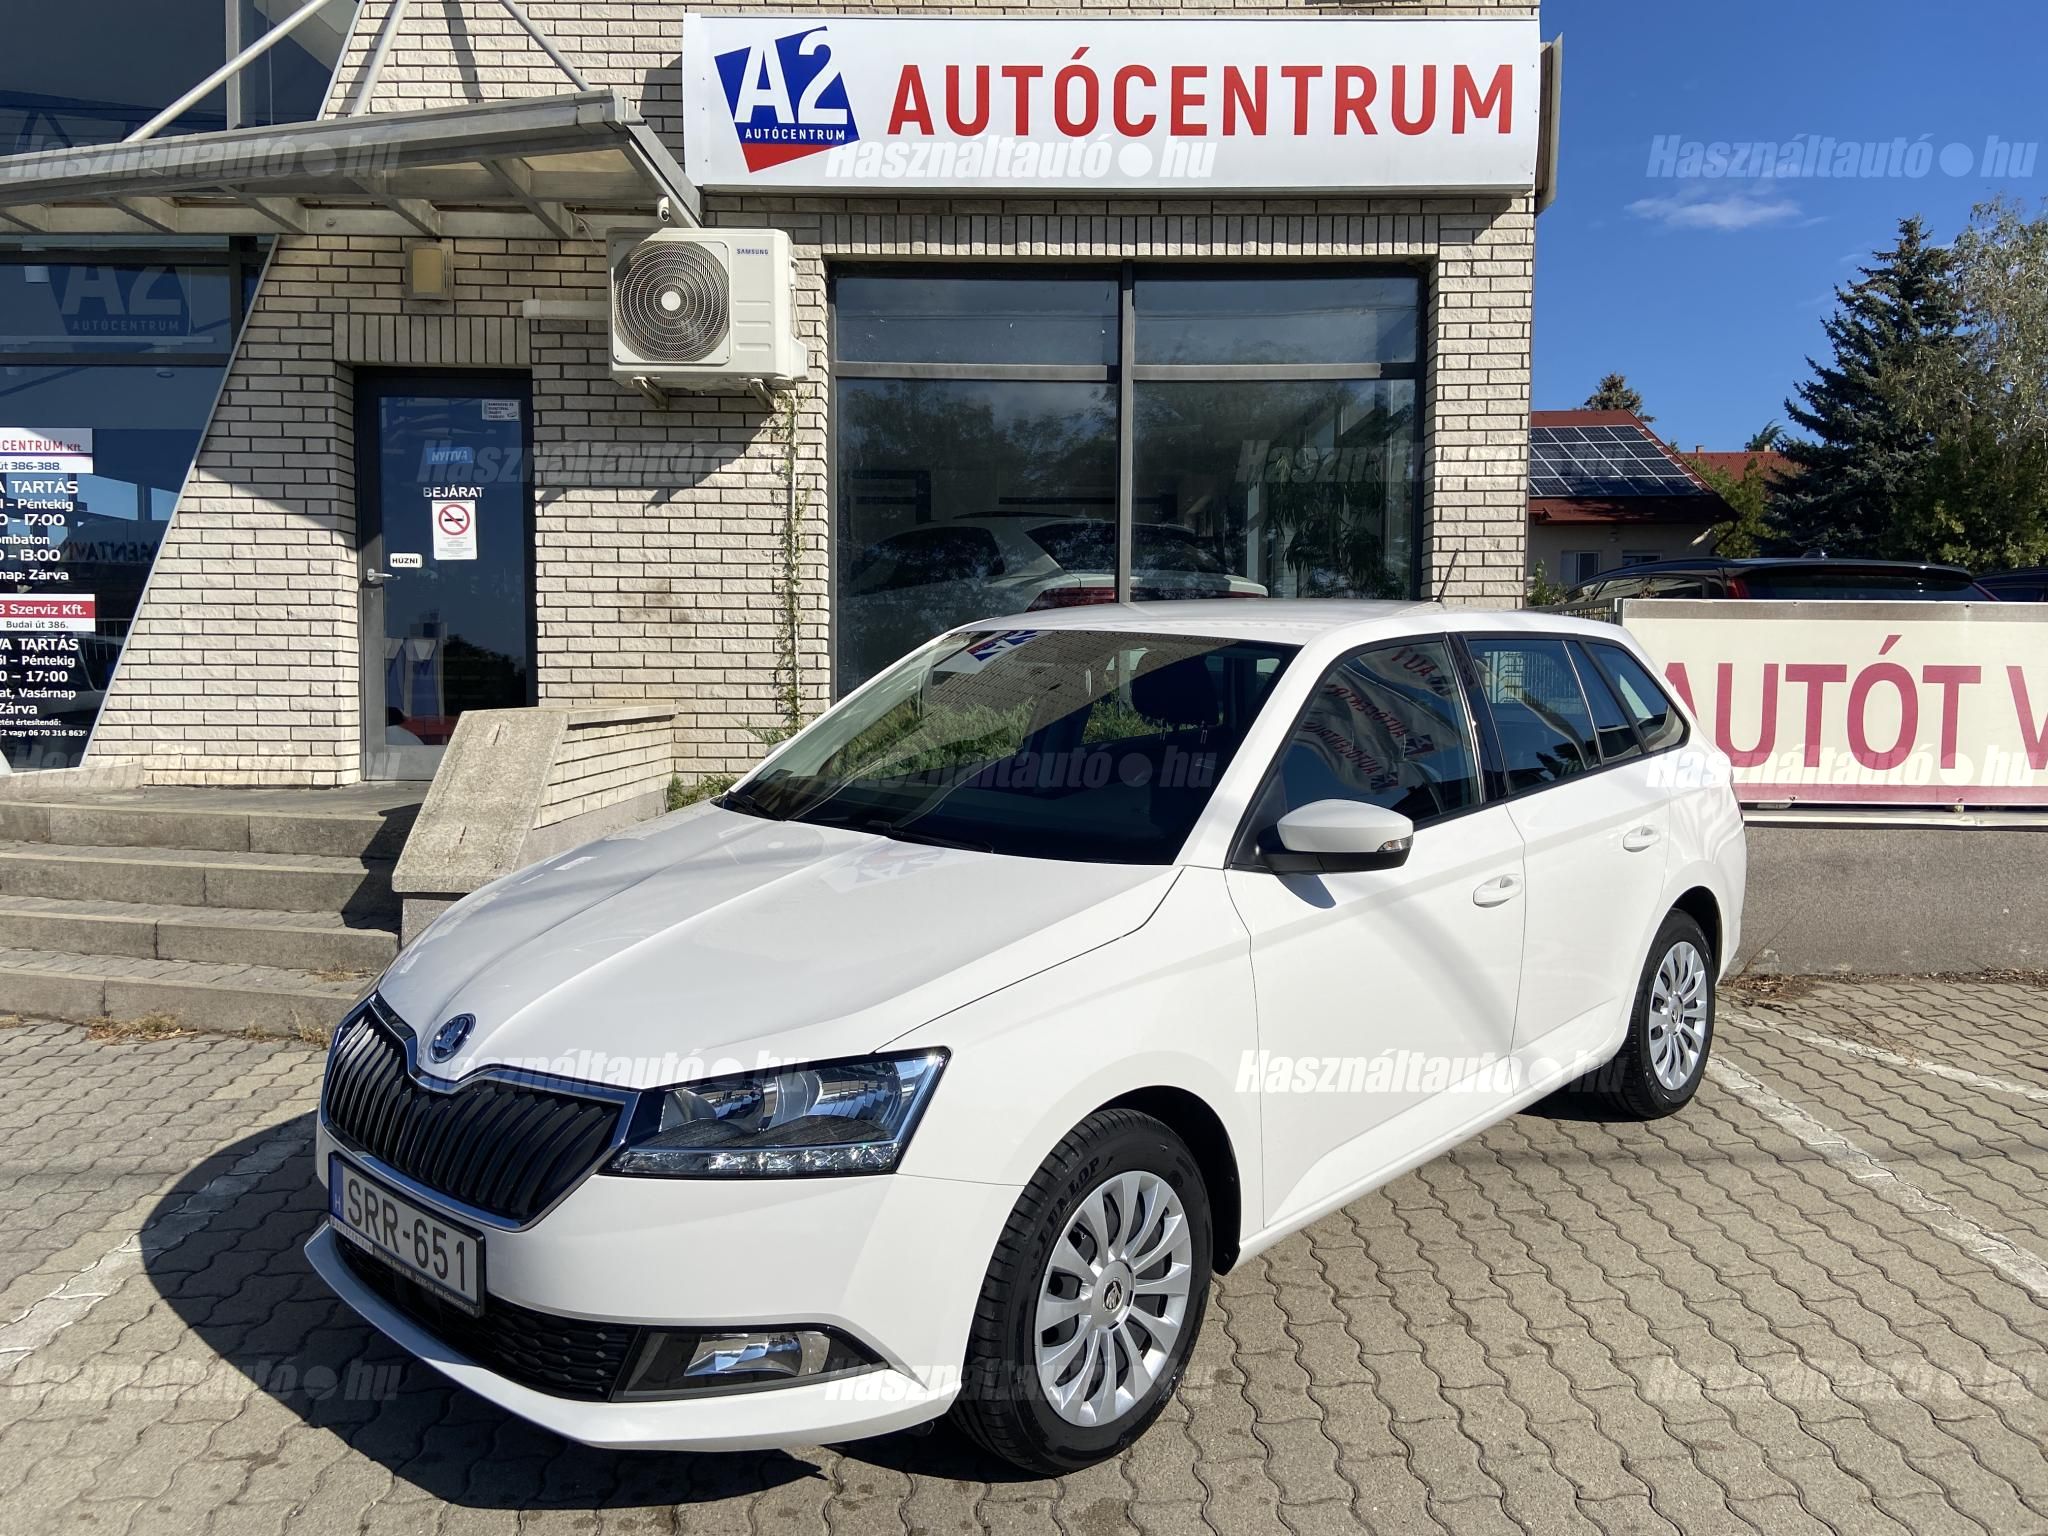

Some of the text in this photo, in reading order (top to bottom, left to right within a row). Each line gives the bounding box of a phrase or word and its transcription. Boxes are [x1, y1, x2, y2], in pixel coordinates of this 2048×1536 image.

[734, 30, 848, 125] A2
[887, 46, 1513, 137] AUTÓCENTRUM
[745, 126, 845, 140] AUTÓCENTRUM
[72, 318, 179, 331] AUTÓCENTRUM
[0, 440, 63, 451] CENTRUM
[431, 450, 468, 462] NYITVA
[11, 477, 79, 494] TARTÁS
[423, 484, 485, 498] BEJÁRAT
[18, 498, 74, 512] Péntekig
[24, 513, 65, 526] 17:00
[20, 549, 61, 561] 13:00
[28, 568, 69, 580] Zárva
[9, 603, 59, 615] Szerviz
[62, 604, 87, 615] Kft.
[6, 620, 69, 629] Budai út 386.
[18, 634, 79, 651] TARTÁS
[21, 655, 76, 668] Péntekig
[26, 670, 68, 682] 17:00
[19, 686, 77, 700] Vasárnap
[1665, 634, 1982, 770] AUTÓT
[9, 730, 27, 738] vagy
[28, 729, 39, 737] 06
[40, 729, 50, 737] 70
[52, 729, 67, 737] 316
[347, 1177, 466, 1292] SRR-651
